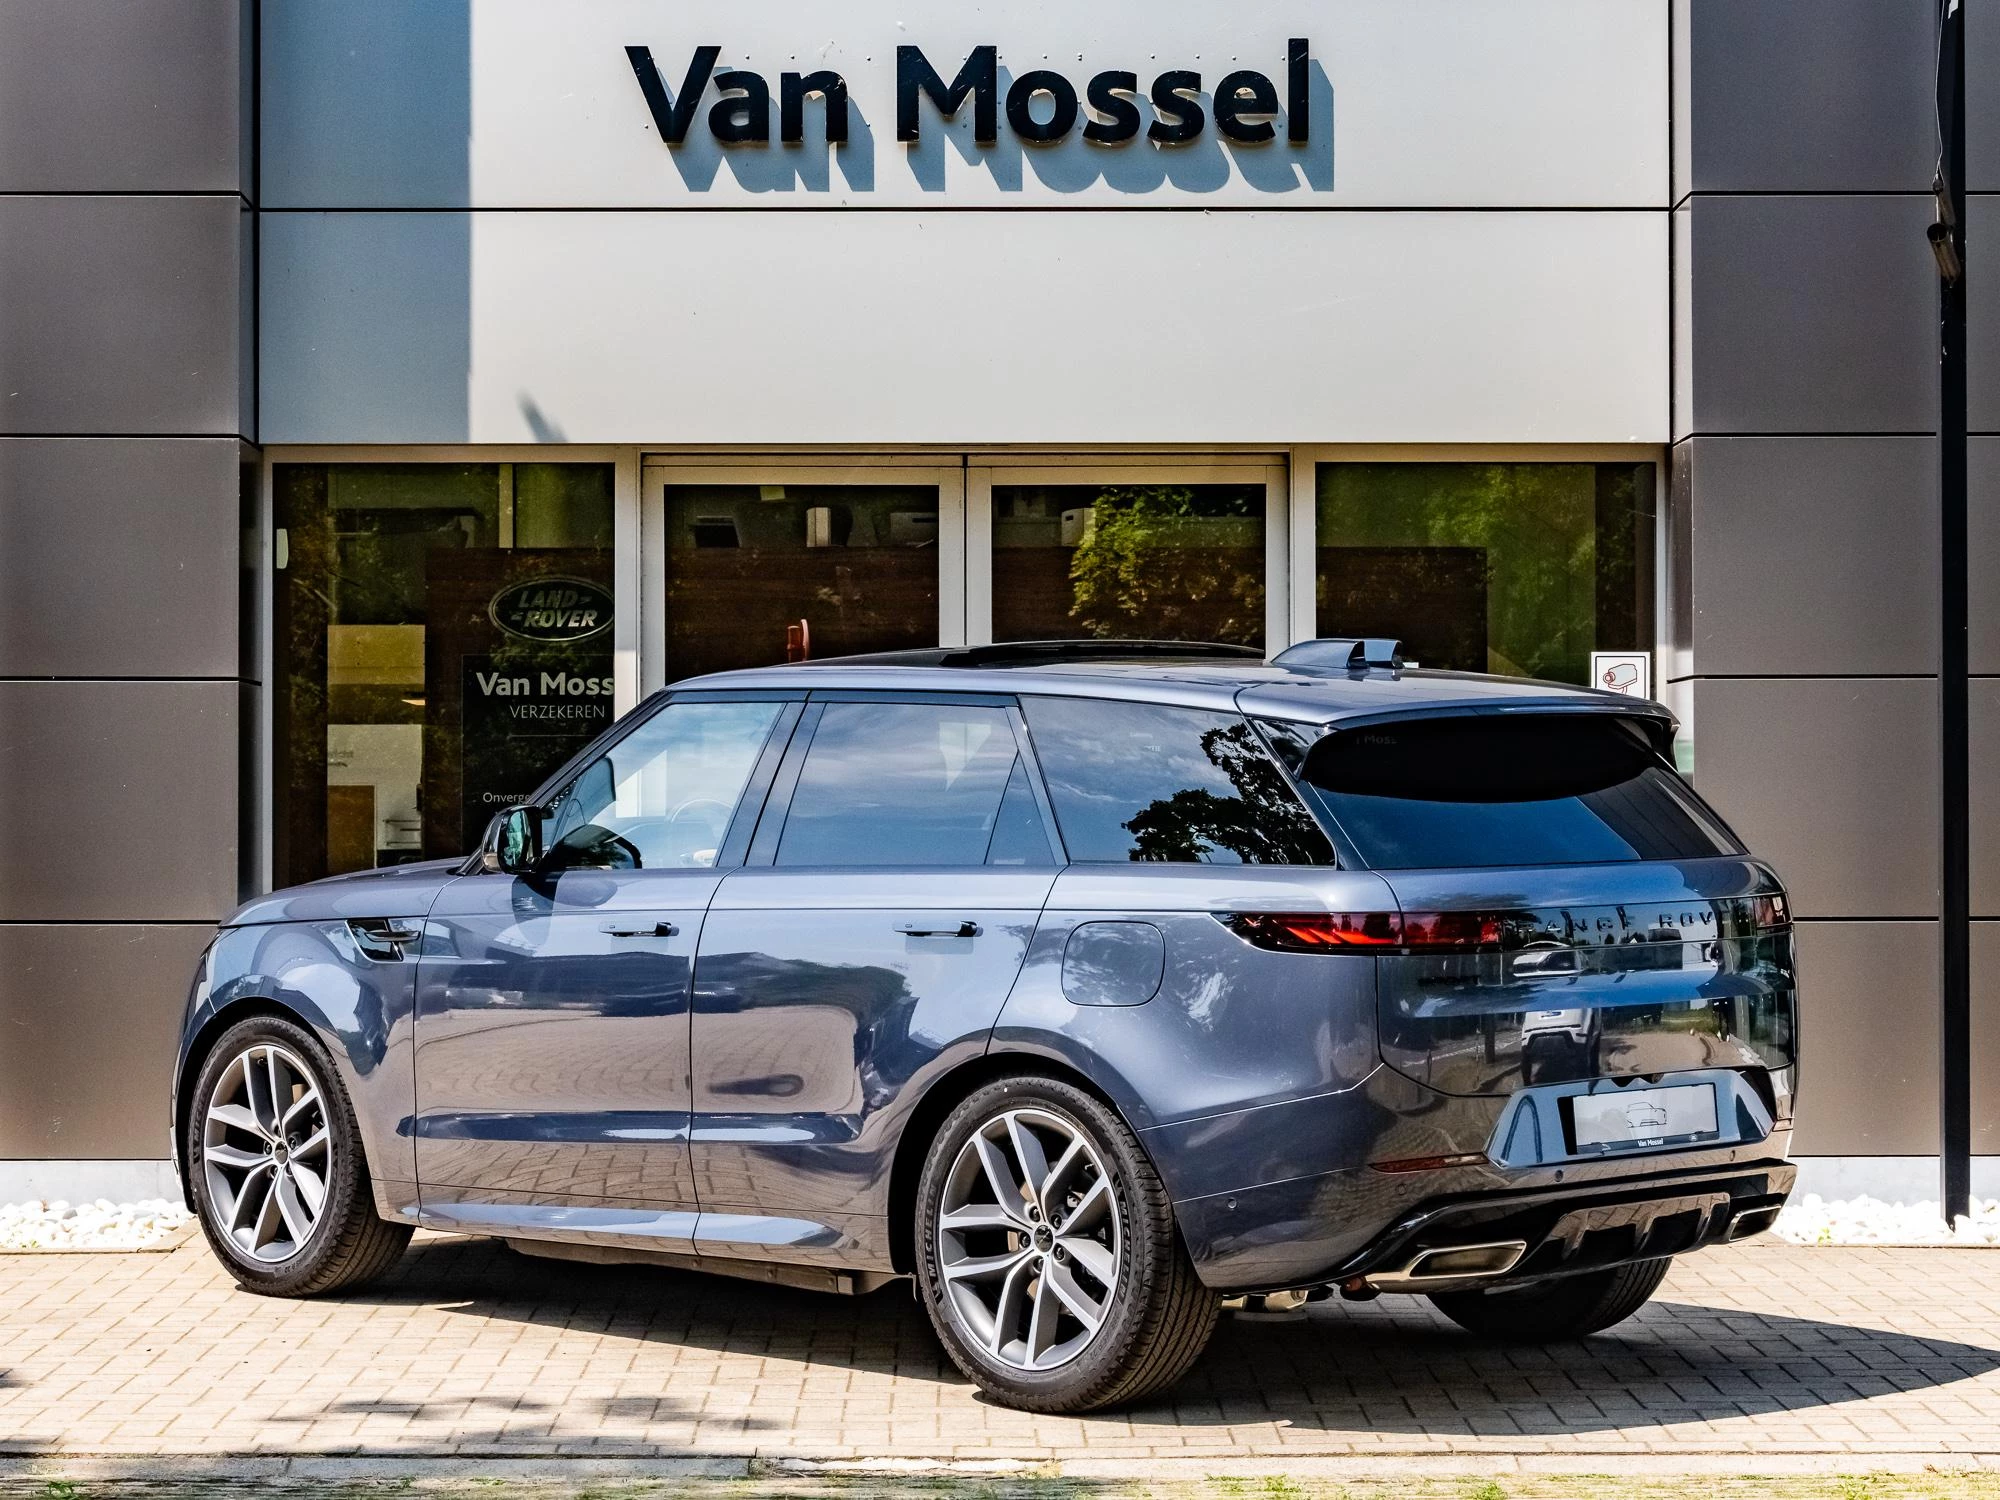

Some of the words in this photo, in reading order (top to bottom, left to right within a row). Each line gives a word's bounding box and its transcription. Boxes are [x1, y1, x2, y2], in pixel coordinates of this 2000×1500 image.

[624, 45, 849, 143] Van
[896, 38, 1310, 144] Mossel
[518, 590, 578, 608] LAND
[523, 609, 598, 628] ROVER
[476, 672, 530, 696] Van
[540, 672, 615, 696] Moss
[509, 705, 605, 719] VERZEKEREN
[925, 1185, 937, 1278] MICHELIN
[1118, 1200, 1131, 1299] MICHELIN
